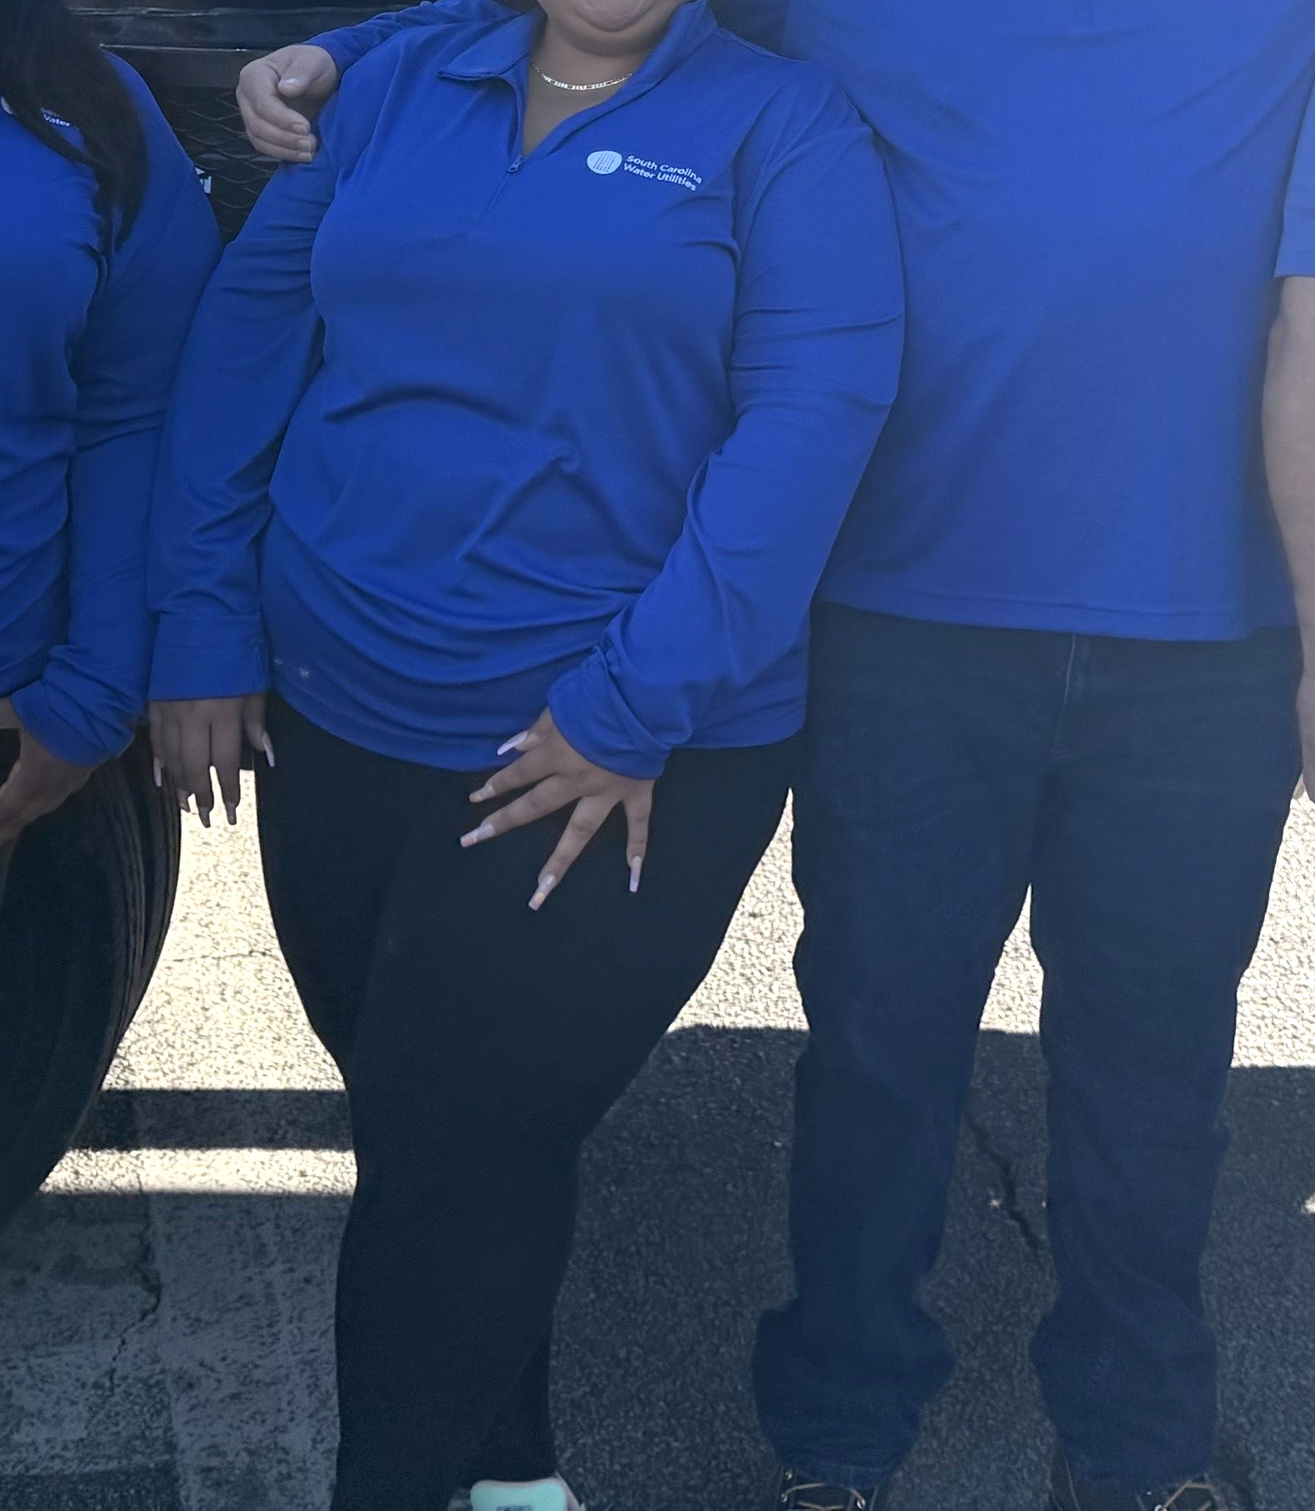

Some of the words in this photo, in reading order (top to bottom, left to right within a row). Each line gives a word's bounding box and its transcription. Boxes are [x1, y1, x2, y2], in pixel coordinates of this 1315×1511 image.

[624, 162, 656, 179] Water
[656, 172, 697, 192] Utilities
[626, 155, 658, 171] South
[659, 164, 702, 184] Carolina
